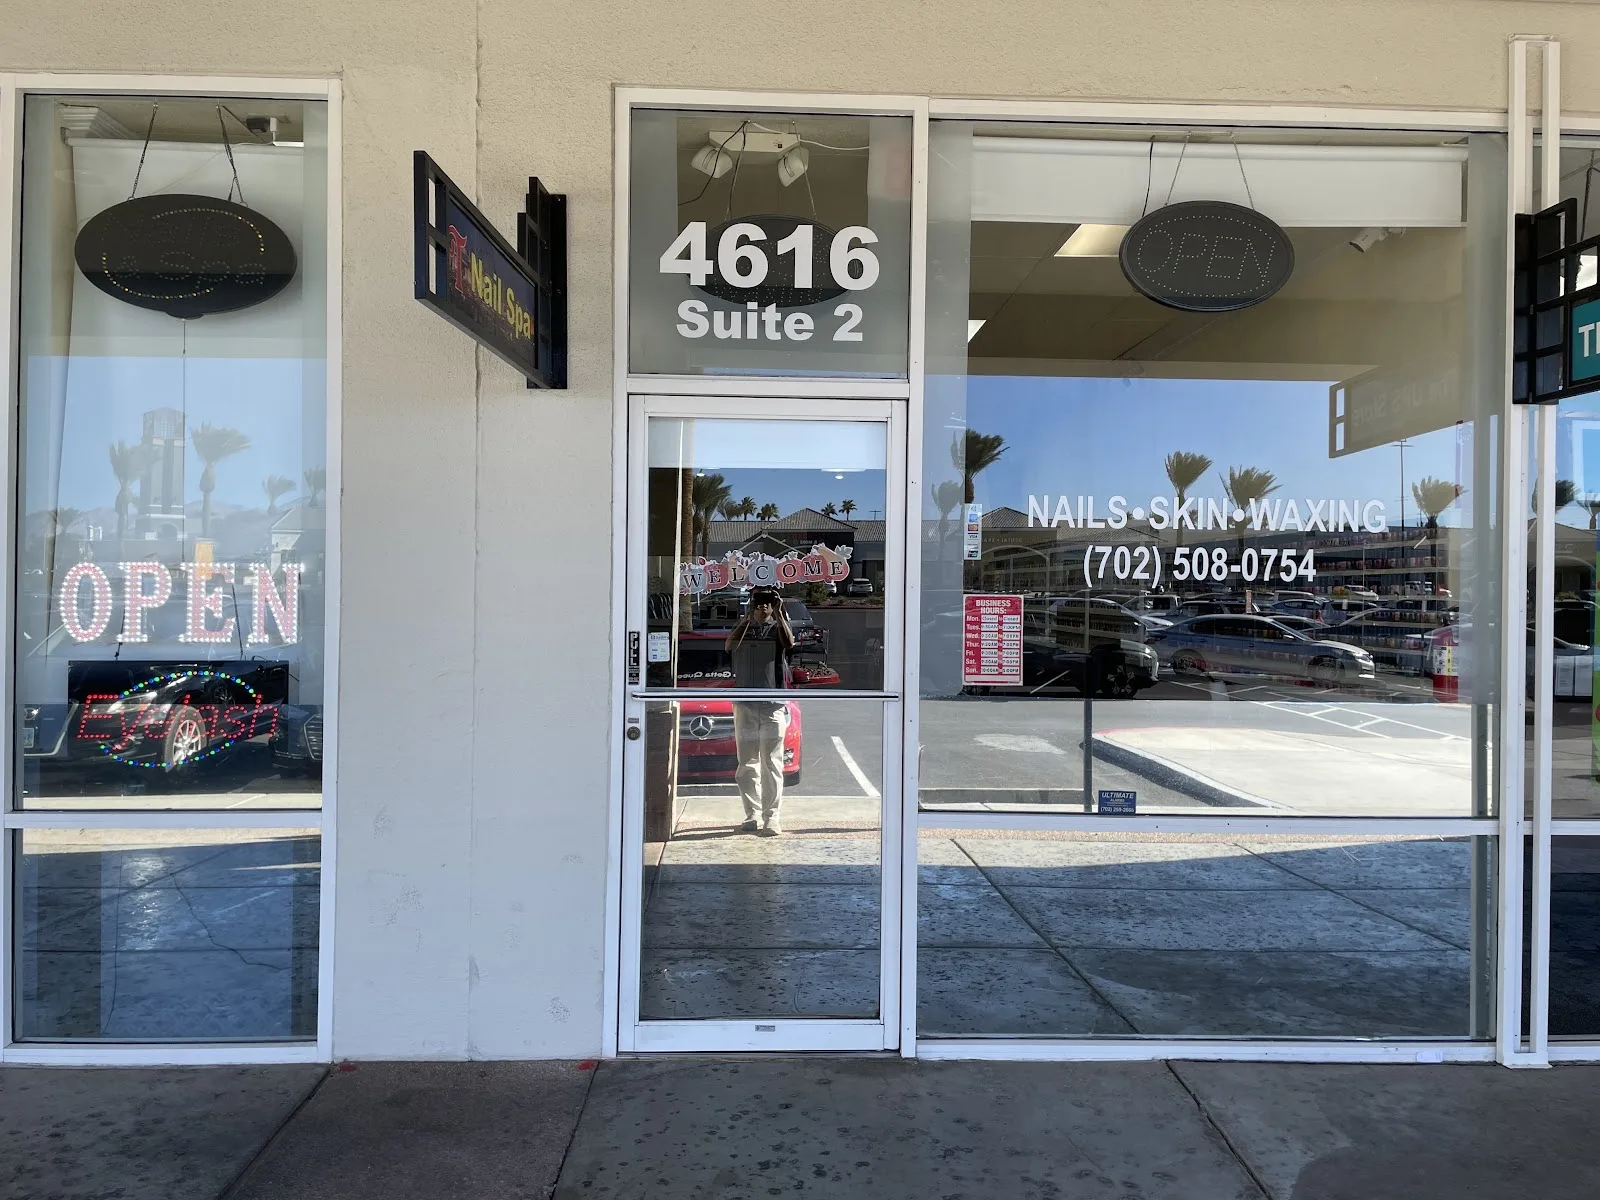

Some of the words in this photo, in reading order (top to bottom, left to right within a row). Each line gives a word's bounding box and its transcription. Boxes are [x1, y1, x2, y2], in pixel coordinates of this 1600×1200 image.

[659, 221, 880, 290] 4616
[1138, 229, 1276, 286] OPEN
[470, 252, 502, 315] Nail
[506, 287, 531, 340] Spa
[676, 299, 814, 341] Suite
[832, 304, 863, 342] 2
[1578, 321, 1600, 358] T
[1028, 494, 1128, 530] NAILS
[1149, 496, 1228, 531] SKIN
[1248, 498, 1386, 534] WAXING
[683, 559, 844, 589] WELCOME
[1083, 546, 1162, 588] (702)
[1173, 548, 1317, 582] 508-0754
[59, 561, 305, 644] OPEN
[630, 632, 638, 666] PULL
[76, 693, 279, 750] Eyelash
